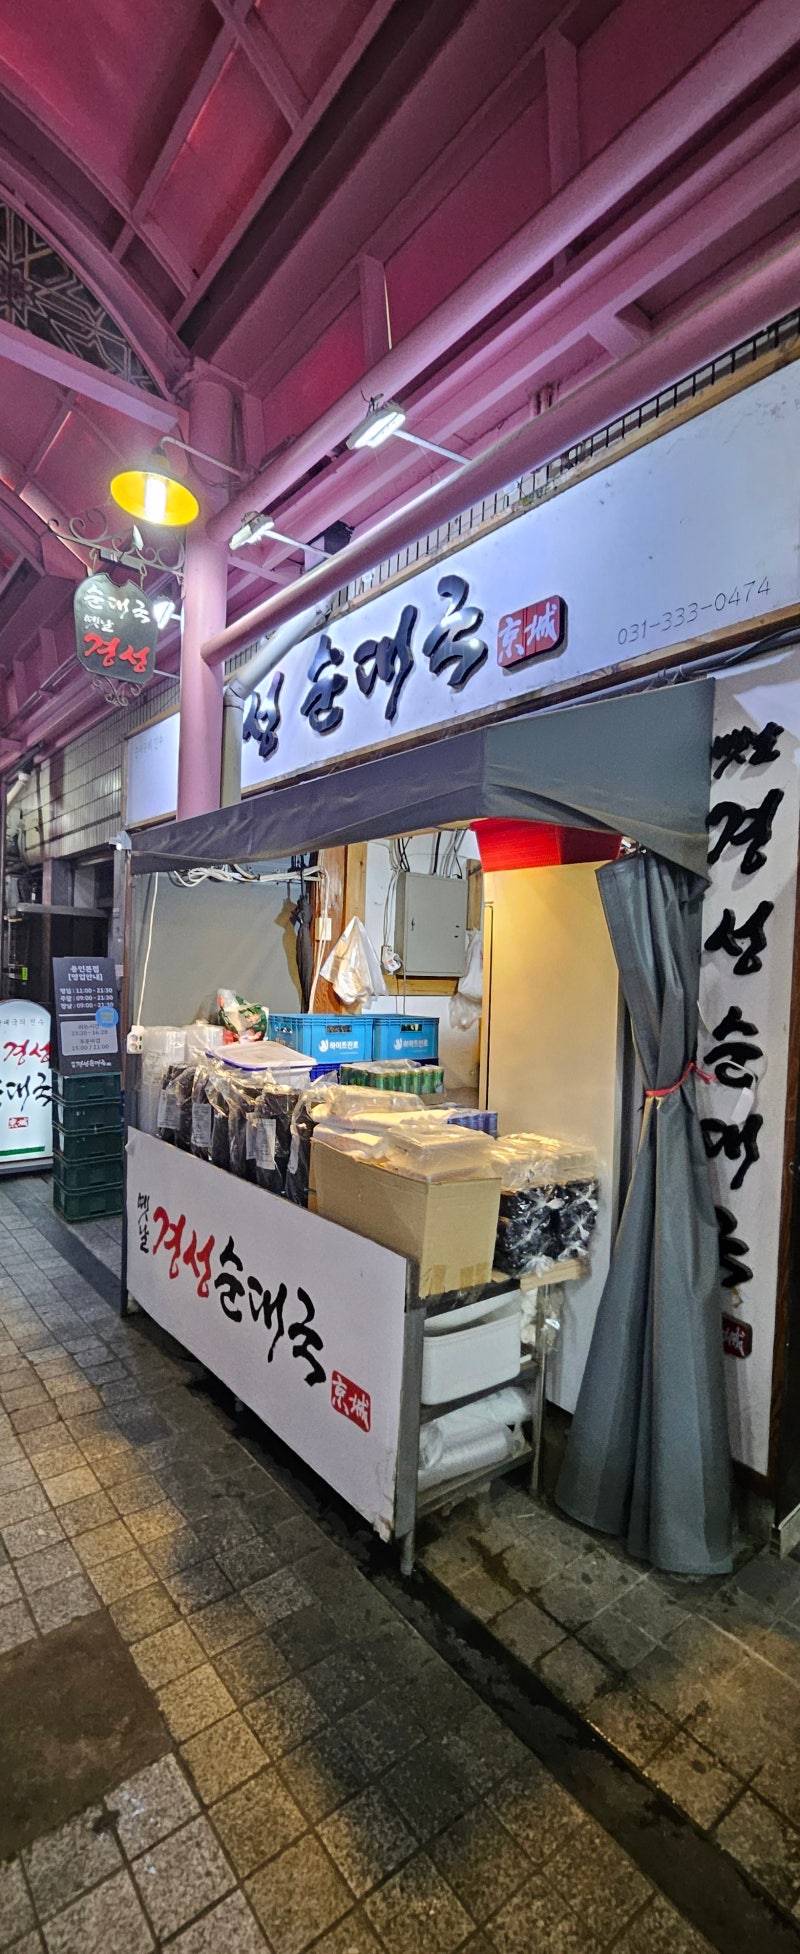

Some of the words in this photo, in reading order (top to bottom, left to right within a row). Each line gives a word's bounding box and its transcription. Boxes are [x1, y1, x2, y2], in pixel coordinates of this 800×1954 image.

[83, 583, 151, 624] 순대국
[617, 576, 771, 645] 031-333-0474
[83, 633, 151, 673] 경성
[329, 1040, 359, 1050] 하이트진로
[0, 1072, 53, 1112] 대국
